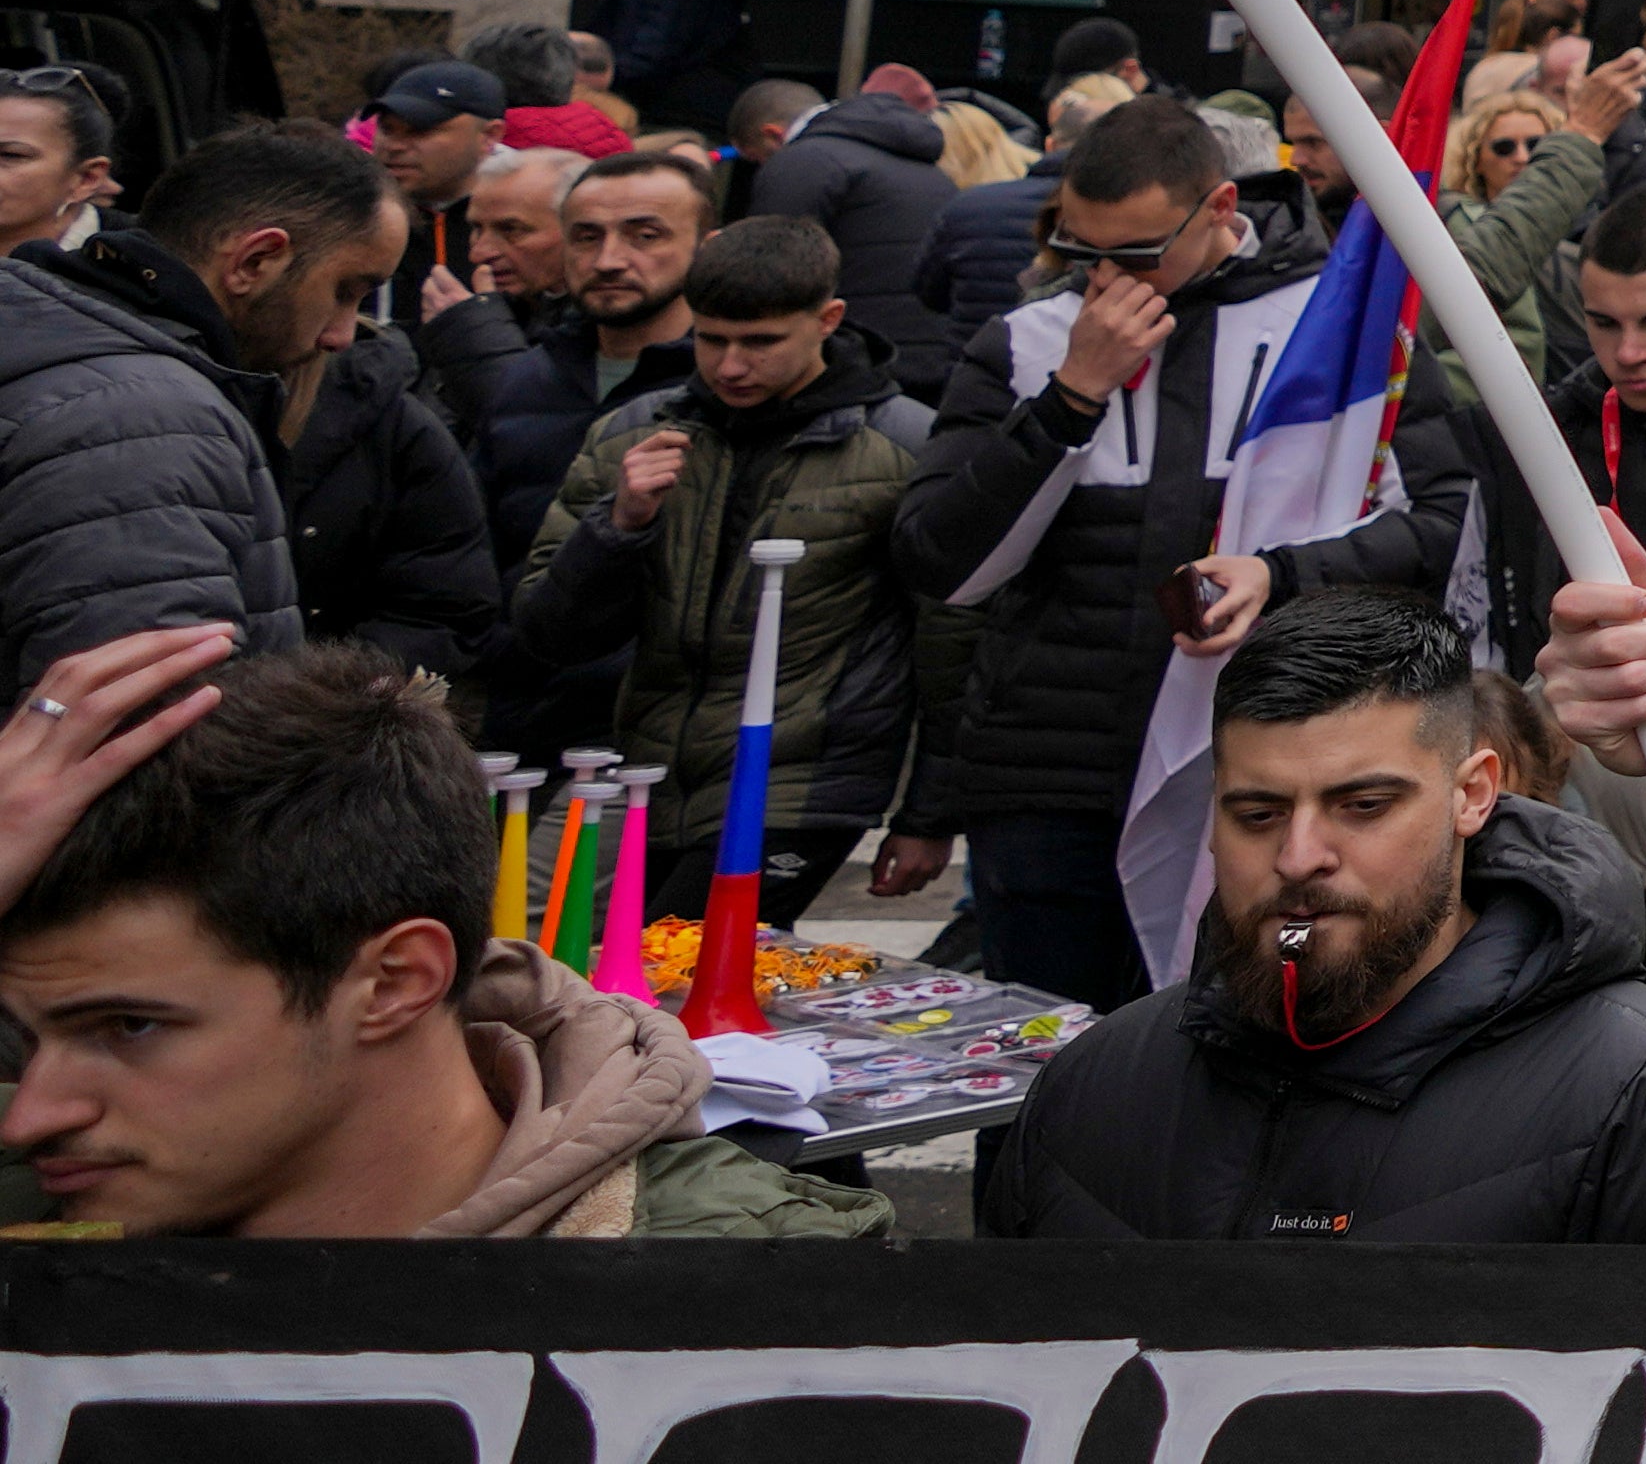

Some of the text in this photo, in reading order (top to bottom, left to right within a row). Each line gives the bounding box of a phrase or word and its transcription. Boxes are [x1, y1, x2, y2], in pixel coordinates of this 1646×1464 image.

[1270, 1214, 1332, 1232] Just do it.
